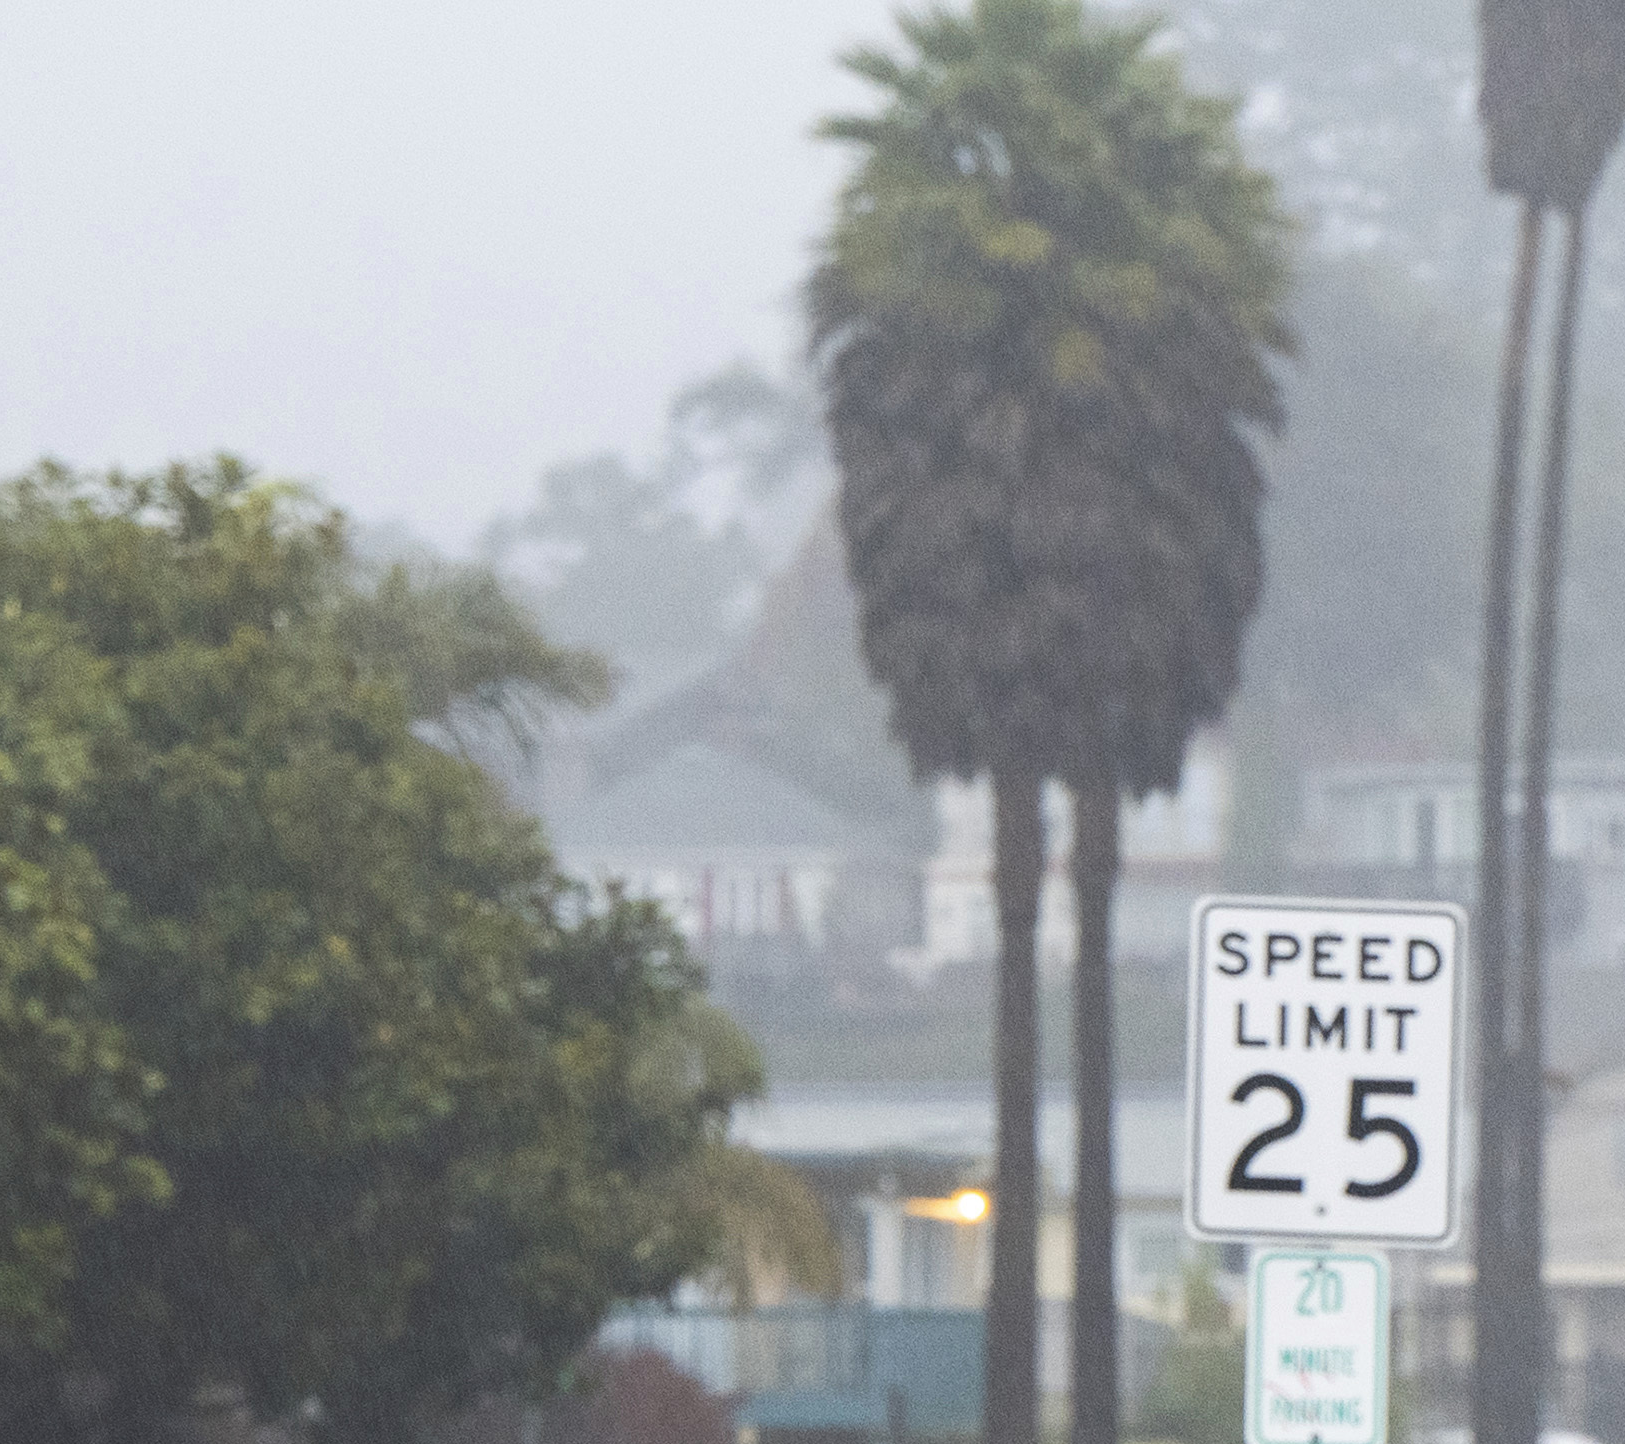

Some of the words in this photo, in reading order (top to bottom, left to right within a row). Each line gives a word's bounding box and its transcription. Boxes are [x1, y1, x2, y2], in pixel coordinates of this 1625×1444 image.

[1217, 931, 1443, 984] SPEED
[1235, 1002, 1417, 1053] LIMIT
[1227, 1072, 1422, 1201] 25
[1295, 1269, 1344, 1317] 20
[1278, 1346, 1358, 1377] MINUTE
[1271, 1397, 1363, 1427] PARKING
